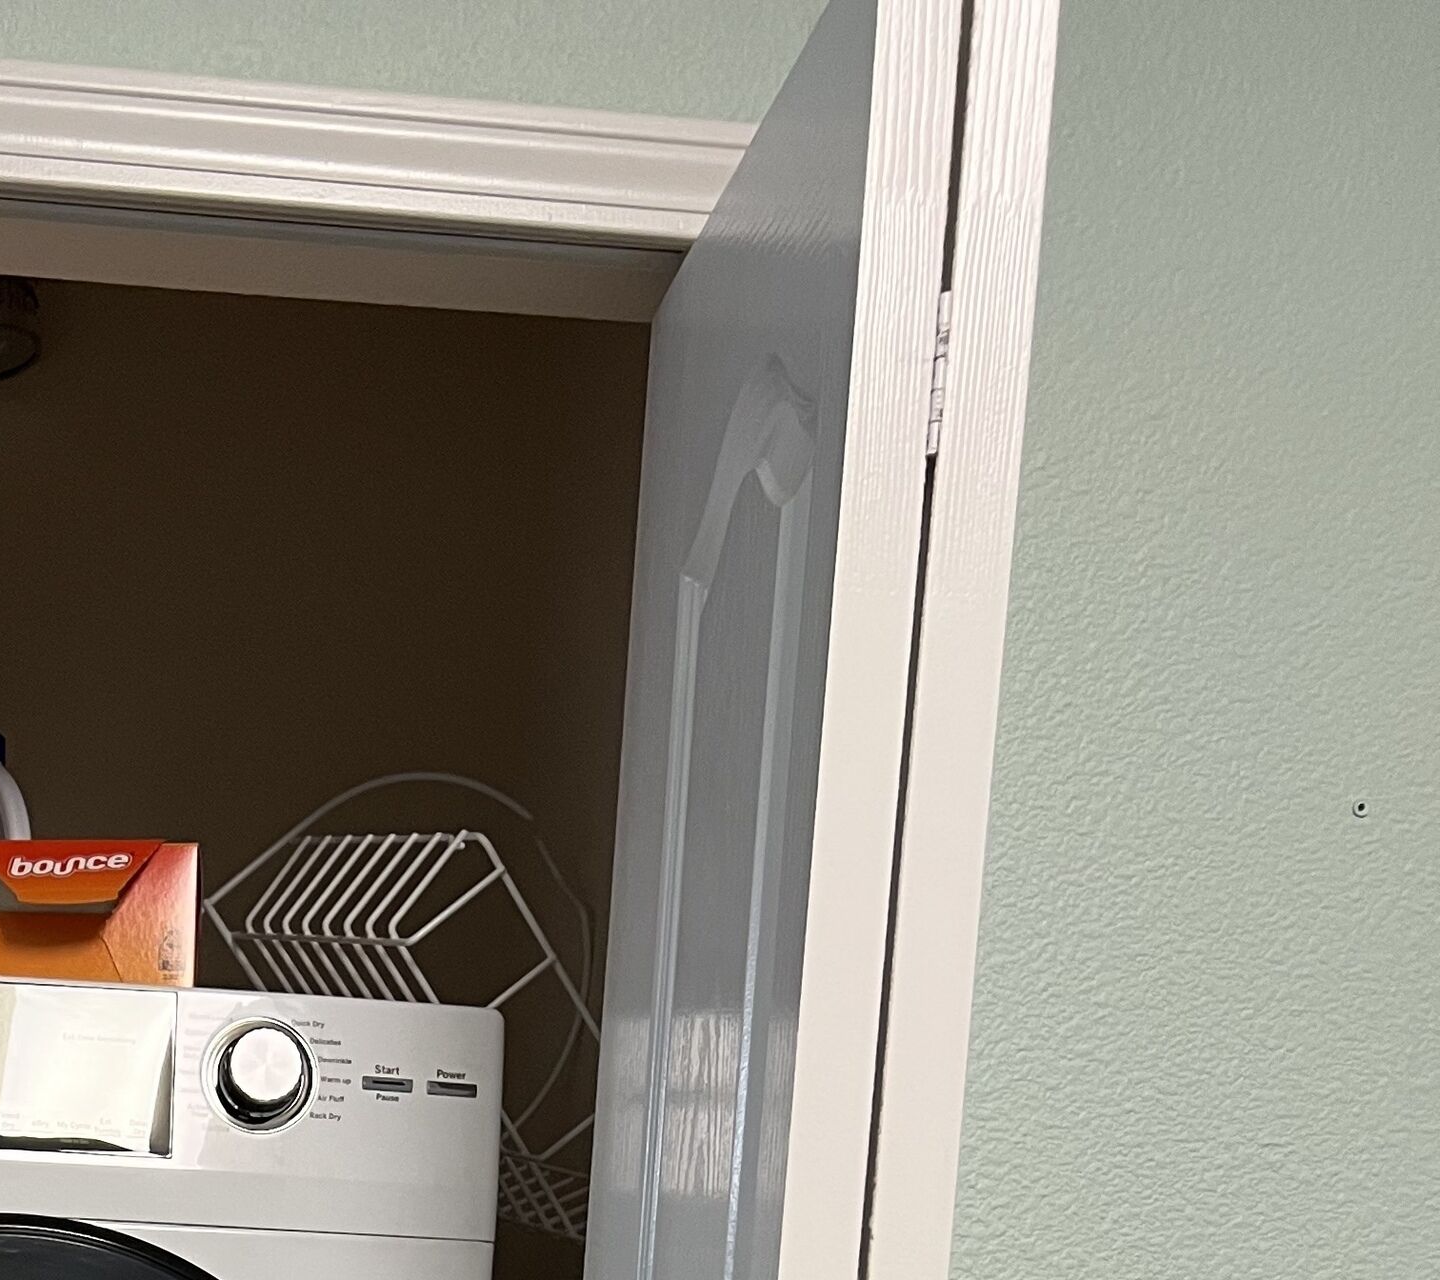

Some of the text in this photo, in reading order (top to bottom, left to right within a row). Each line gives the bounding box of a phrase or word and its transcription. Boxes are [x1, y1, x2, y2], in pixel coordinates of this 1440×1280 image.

[9, 853, 131, 877] bounce
[313, 1021, 325, 1029] Dry
[375, 1064, 466, 1080] Start Power
[376, 1093, 399, 1102] Pause
[329, 1112, 342, 1121] Dry
